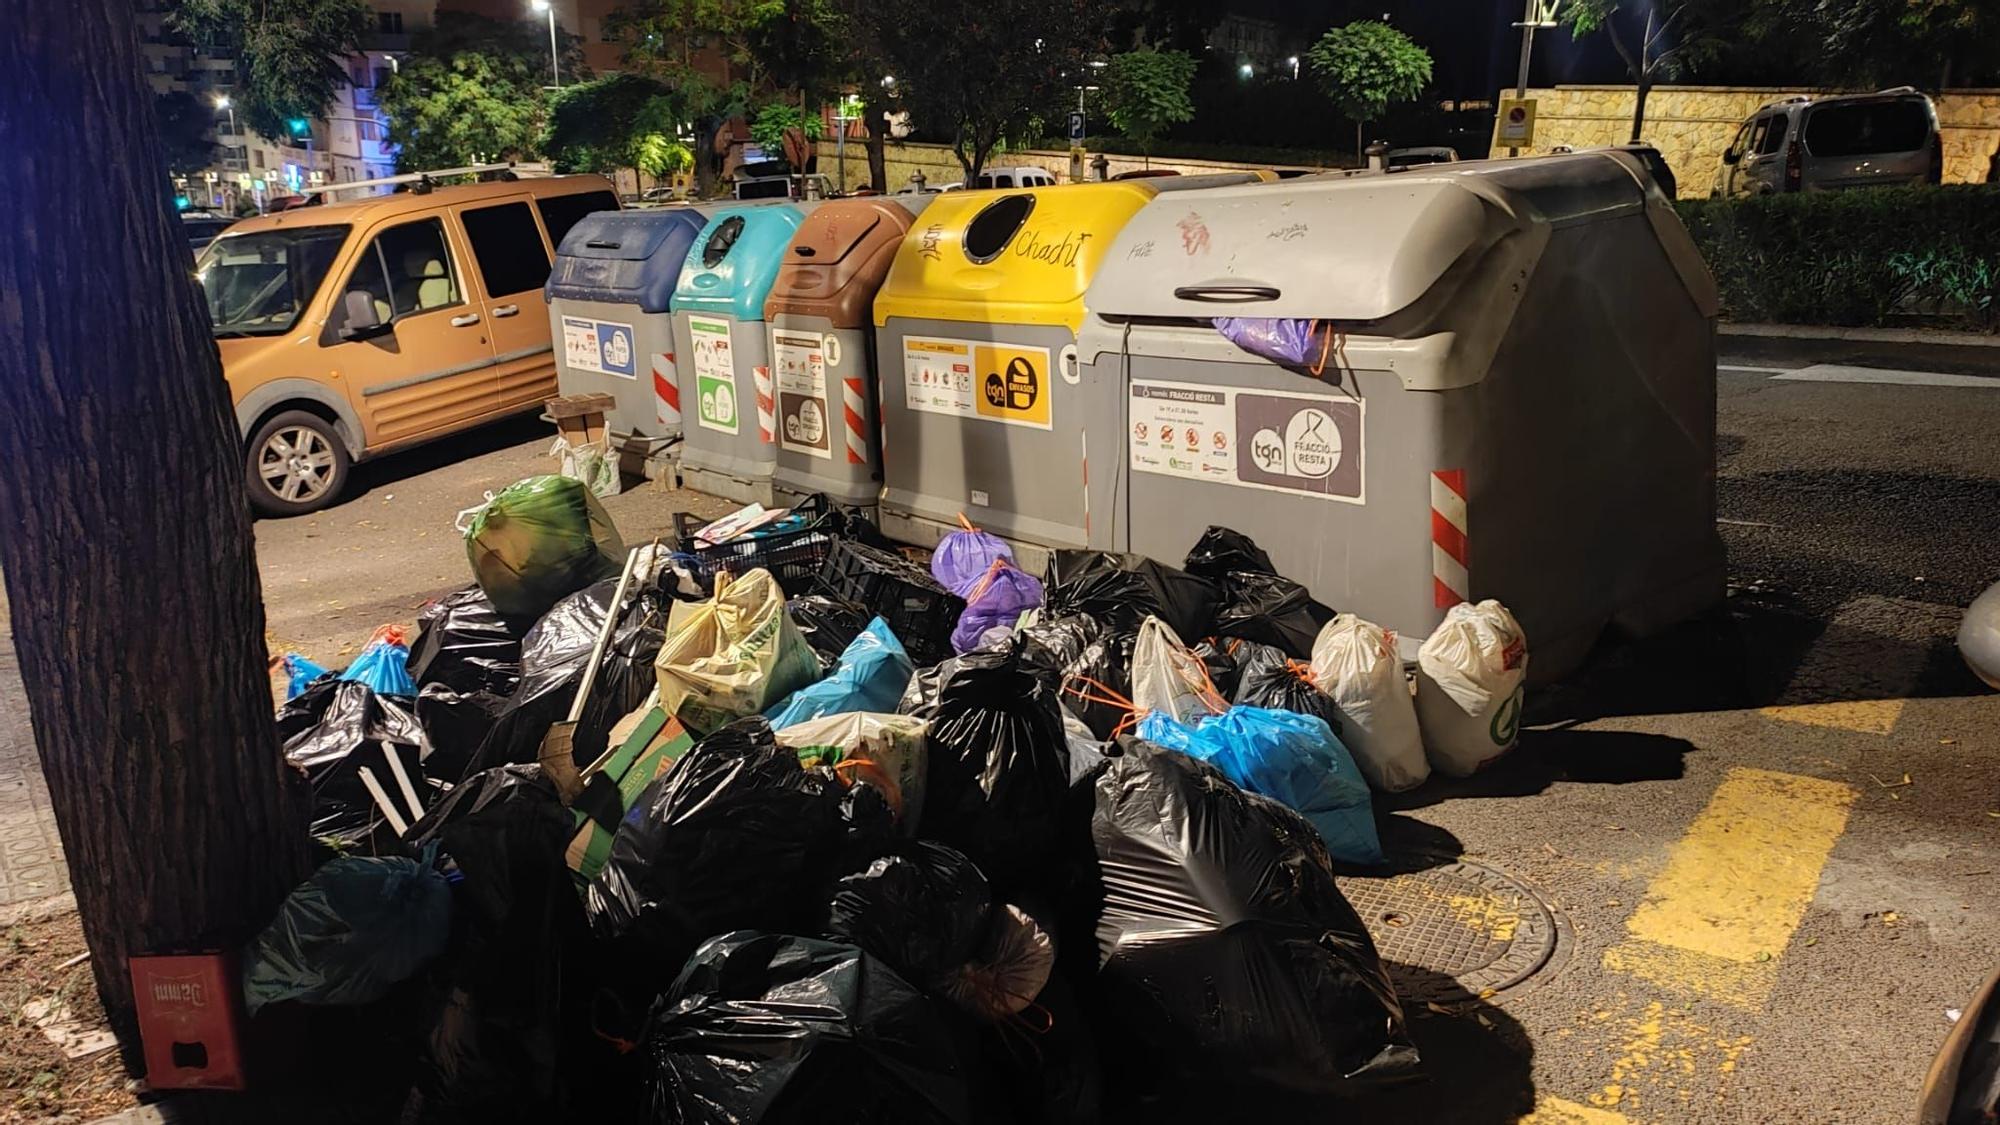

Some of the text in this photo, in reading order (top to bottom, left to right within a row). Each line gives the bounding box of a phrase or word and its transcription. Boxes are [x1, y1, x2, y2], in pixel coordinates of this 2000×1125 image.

[1071, 115, 1082, 136] P
[987, 382, 1004, 403] tgn
[1255, 440, 1282, 468] tgn
[1294, 441, 1330, 454] FRACCIÓ
[1299, 454, 1326, 465] RESTA
